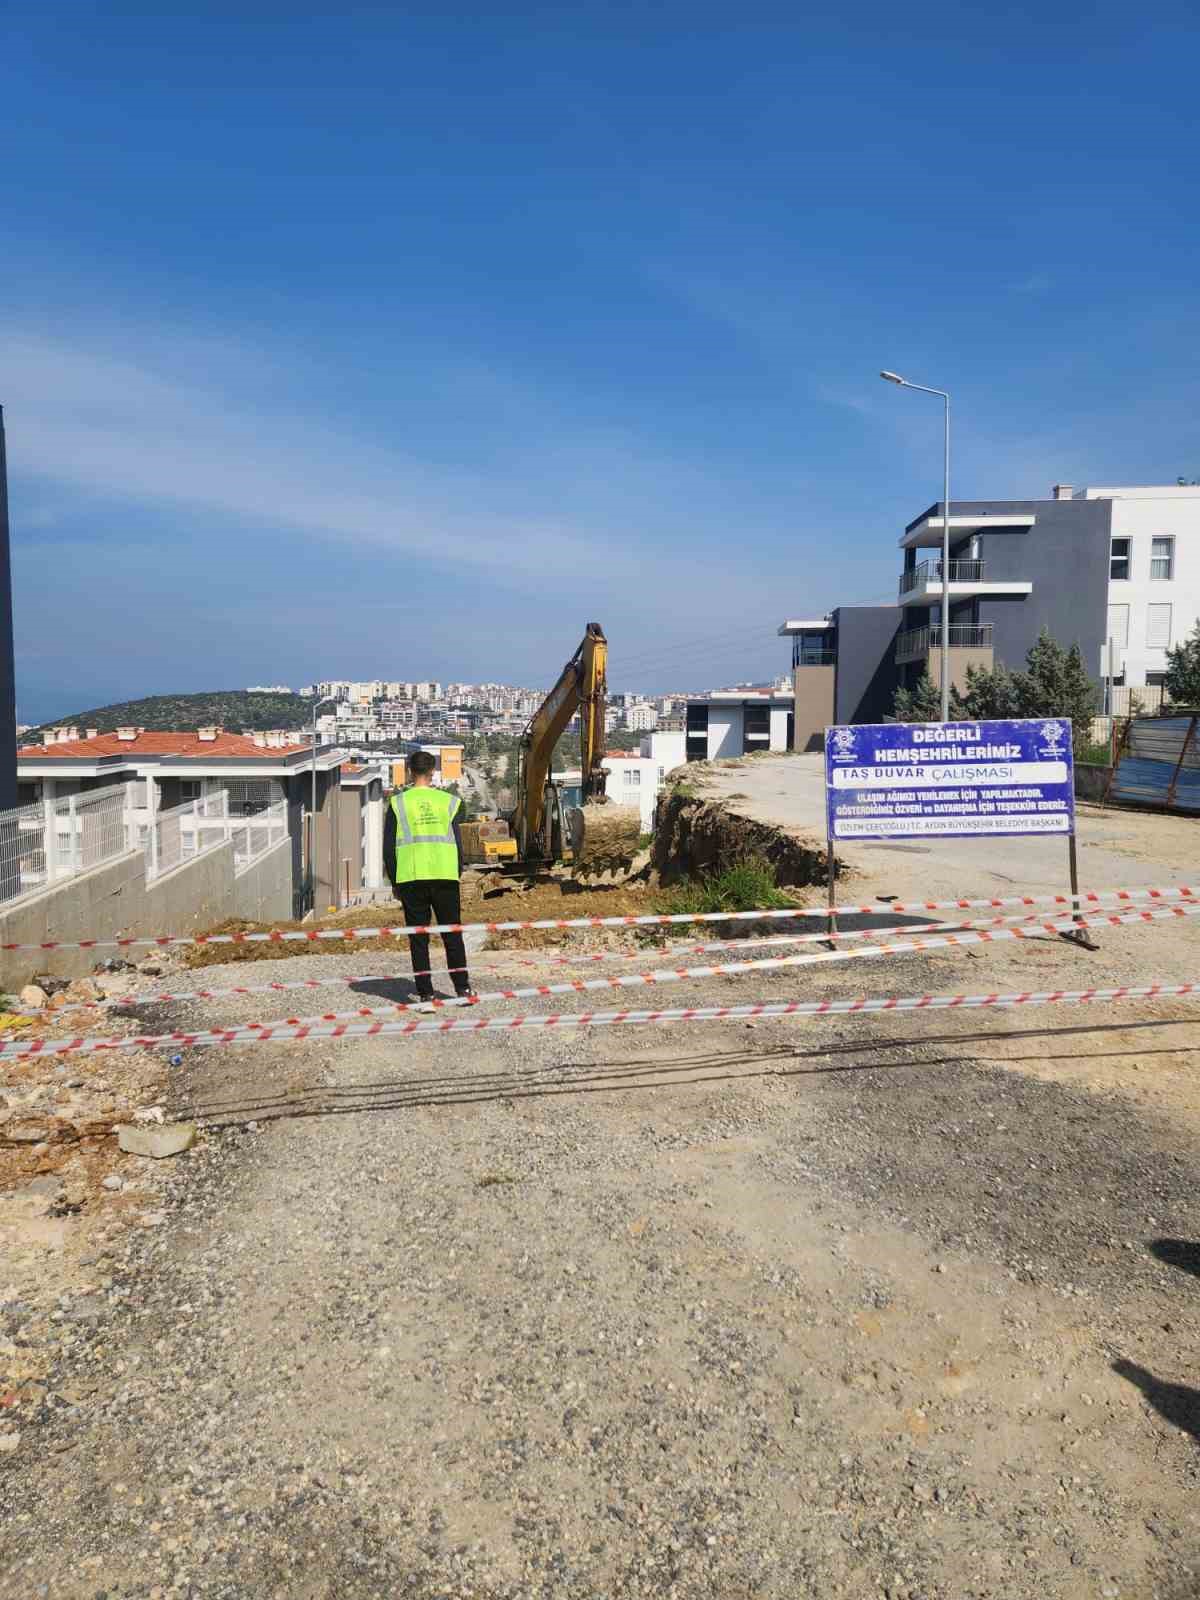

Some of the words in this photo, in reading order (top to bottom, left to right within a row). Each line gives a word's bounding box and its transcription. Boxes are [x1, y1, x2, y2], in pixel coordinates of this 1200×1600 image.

[912, 726, 981, 743] DEĞERLİ
[875, 742, 1022, 764] HEMŞEHRİLERİMİZ
[842, 768, 869, 779] TAŞ
[874, 767, 924, 778] DUVAR
[931, 767, 1013, 781] ÇALIŞMASI
[857, 792, 885, 804] ULAŞIM
[917, 789, 960, 801] YENİLEMEK
[961, 788, 977, 802] İÇİN
[895, 802, 922, 814] ÖZVERİ
[923, 806, 933, 814] ve
[979, 800, 995, 813] İÇİN
[996, 799, 1036, 813] TEŞEKKÜR
